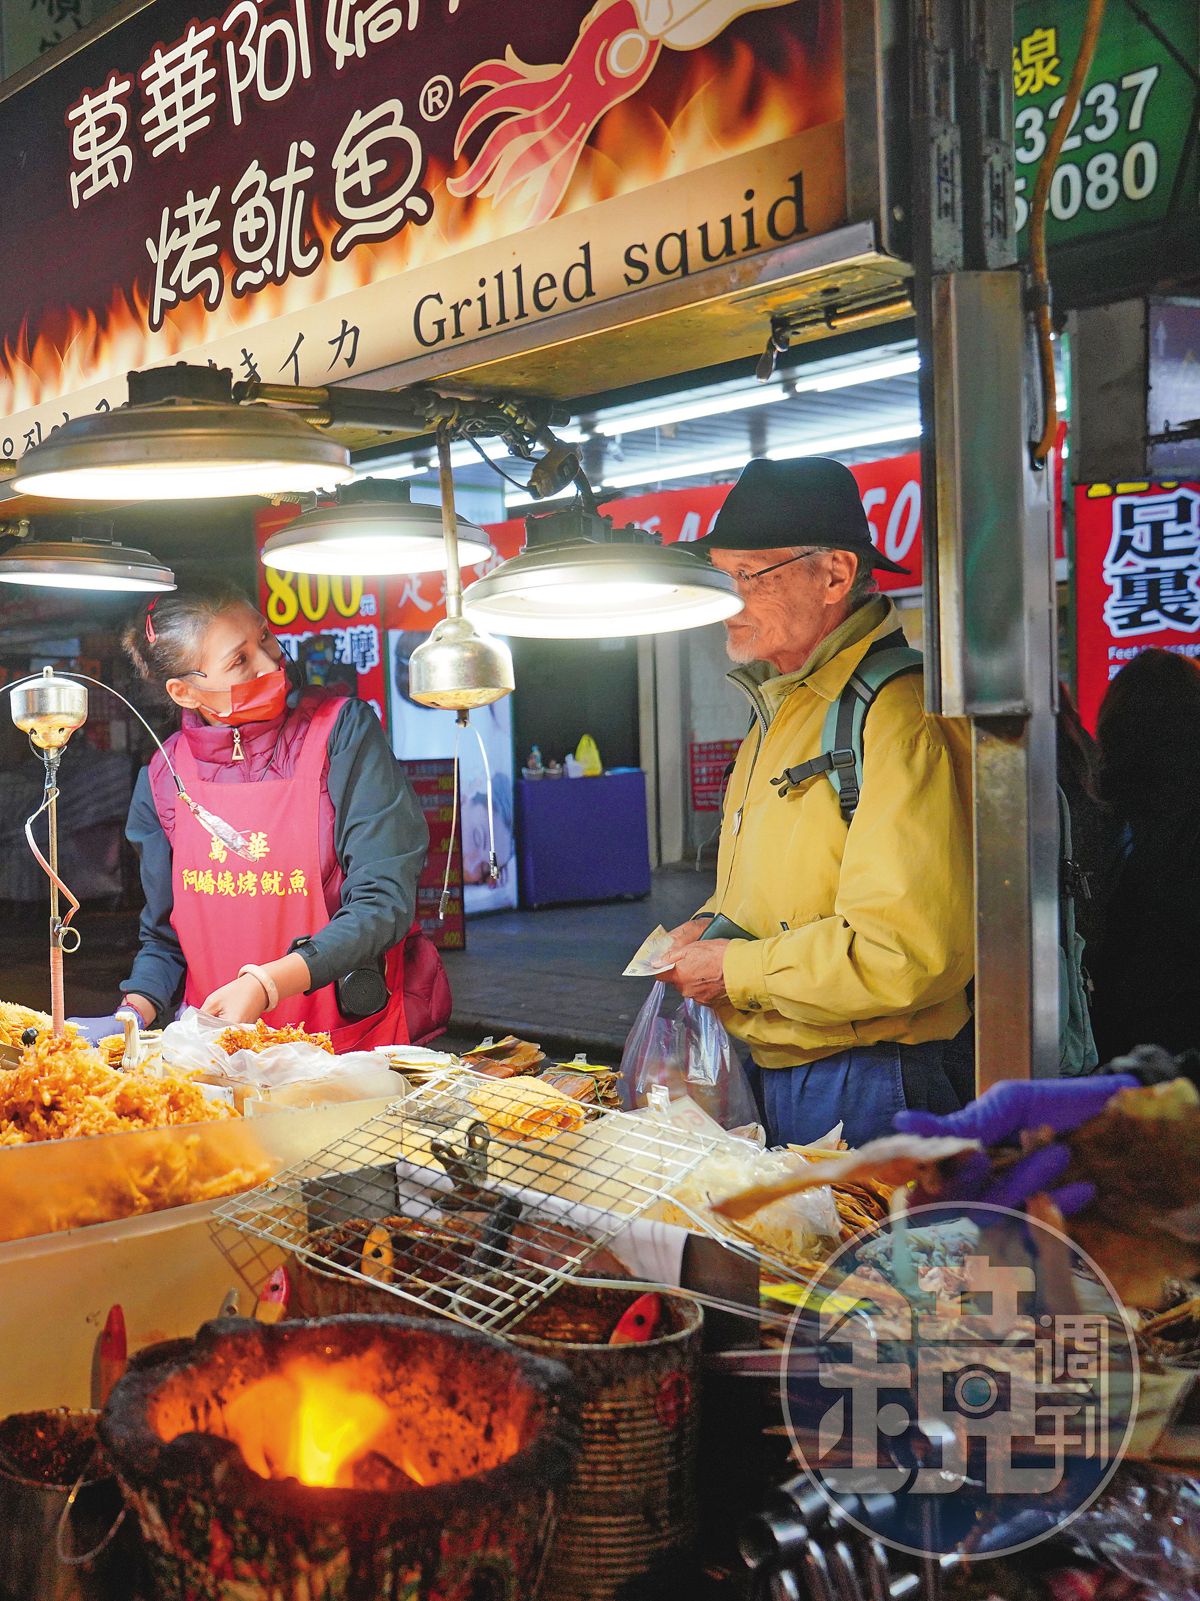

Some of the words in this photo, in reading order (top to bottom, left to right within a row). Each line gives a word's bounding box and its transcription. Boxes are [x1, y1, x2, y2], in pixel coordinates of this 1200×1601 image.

[145, 97, 434, 326] 烤魷魚
[412, 242, 596, 348] Grilled
[622, 171, 808, 287] squid
